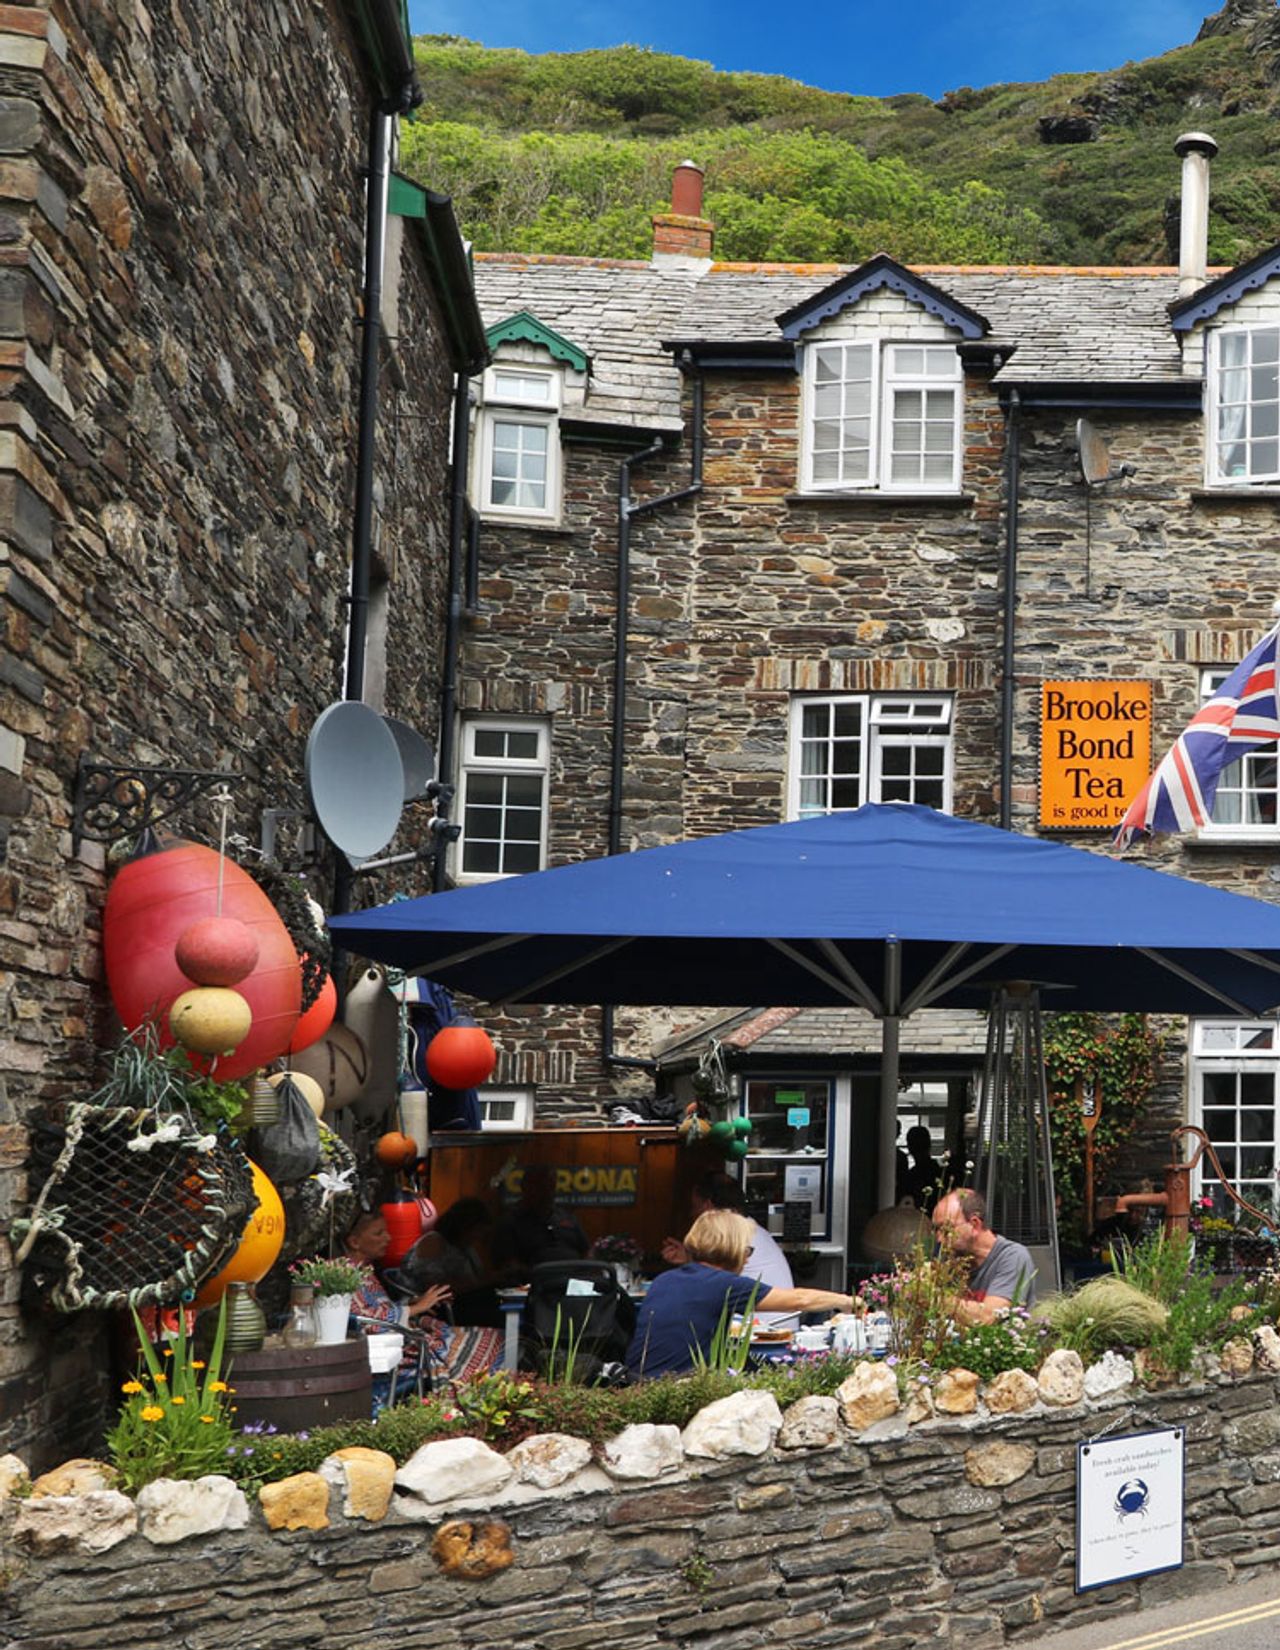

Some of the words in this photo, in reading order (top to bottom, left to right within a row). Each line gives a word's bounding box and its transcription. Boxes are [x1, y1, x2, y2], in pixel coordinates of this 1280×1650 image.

[1046, 692, 1147, 721] Brooke
[1058, 730, 1134, 760] Bond
[1065, 769, 1125, 799] Tea
[1053, 805, 1065, 817] is
[1070, 805, 1108, 820] good
[1114, 806, 1128, 817] te
[505, 1169, 637, 1194] CRONA
